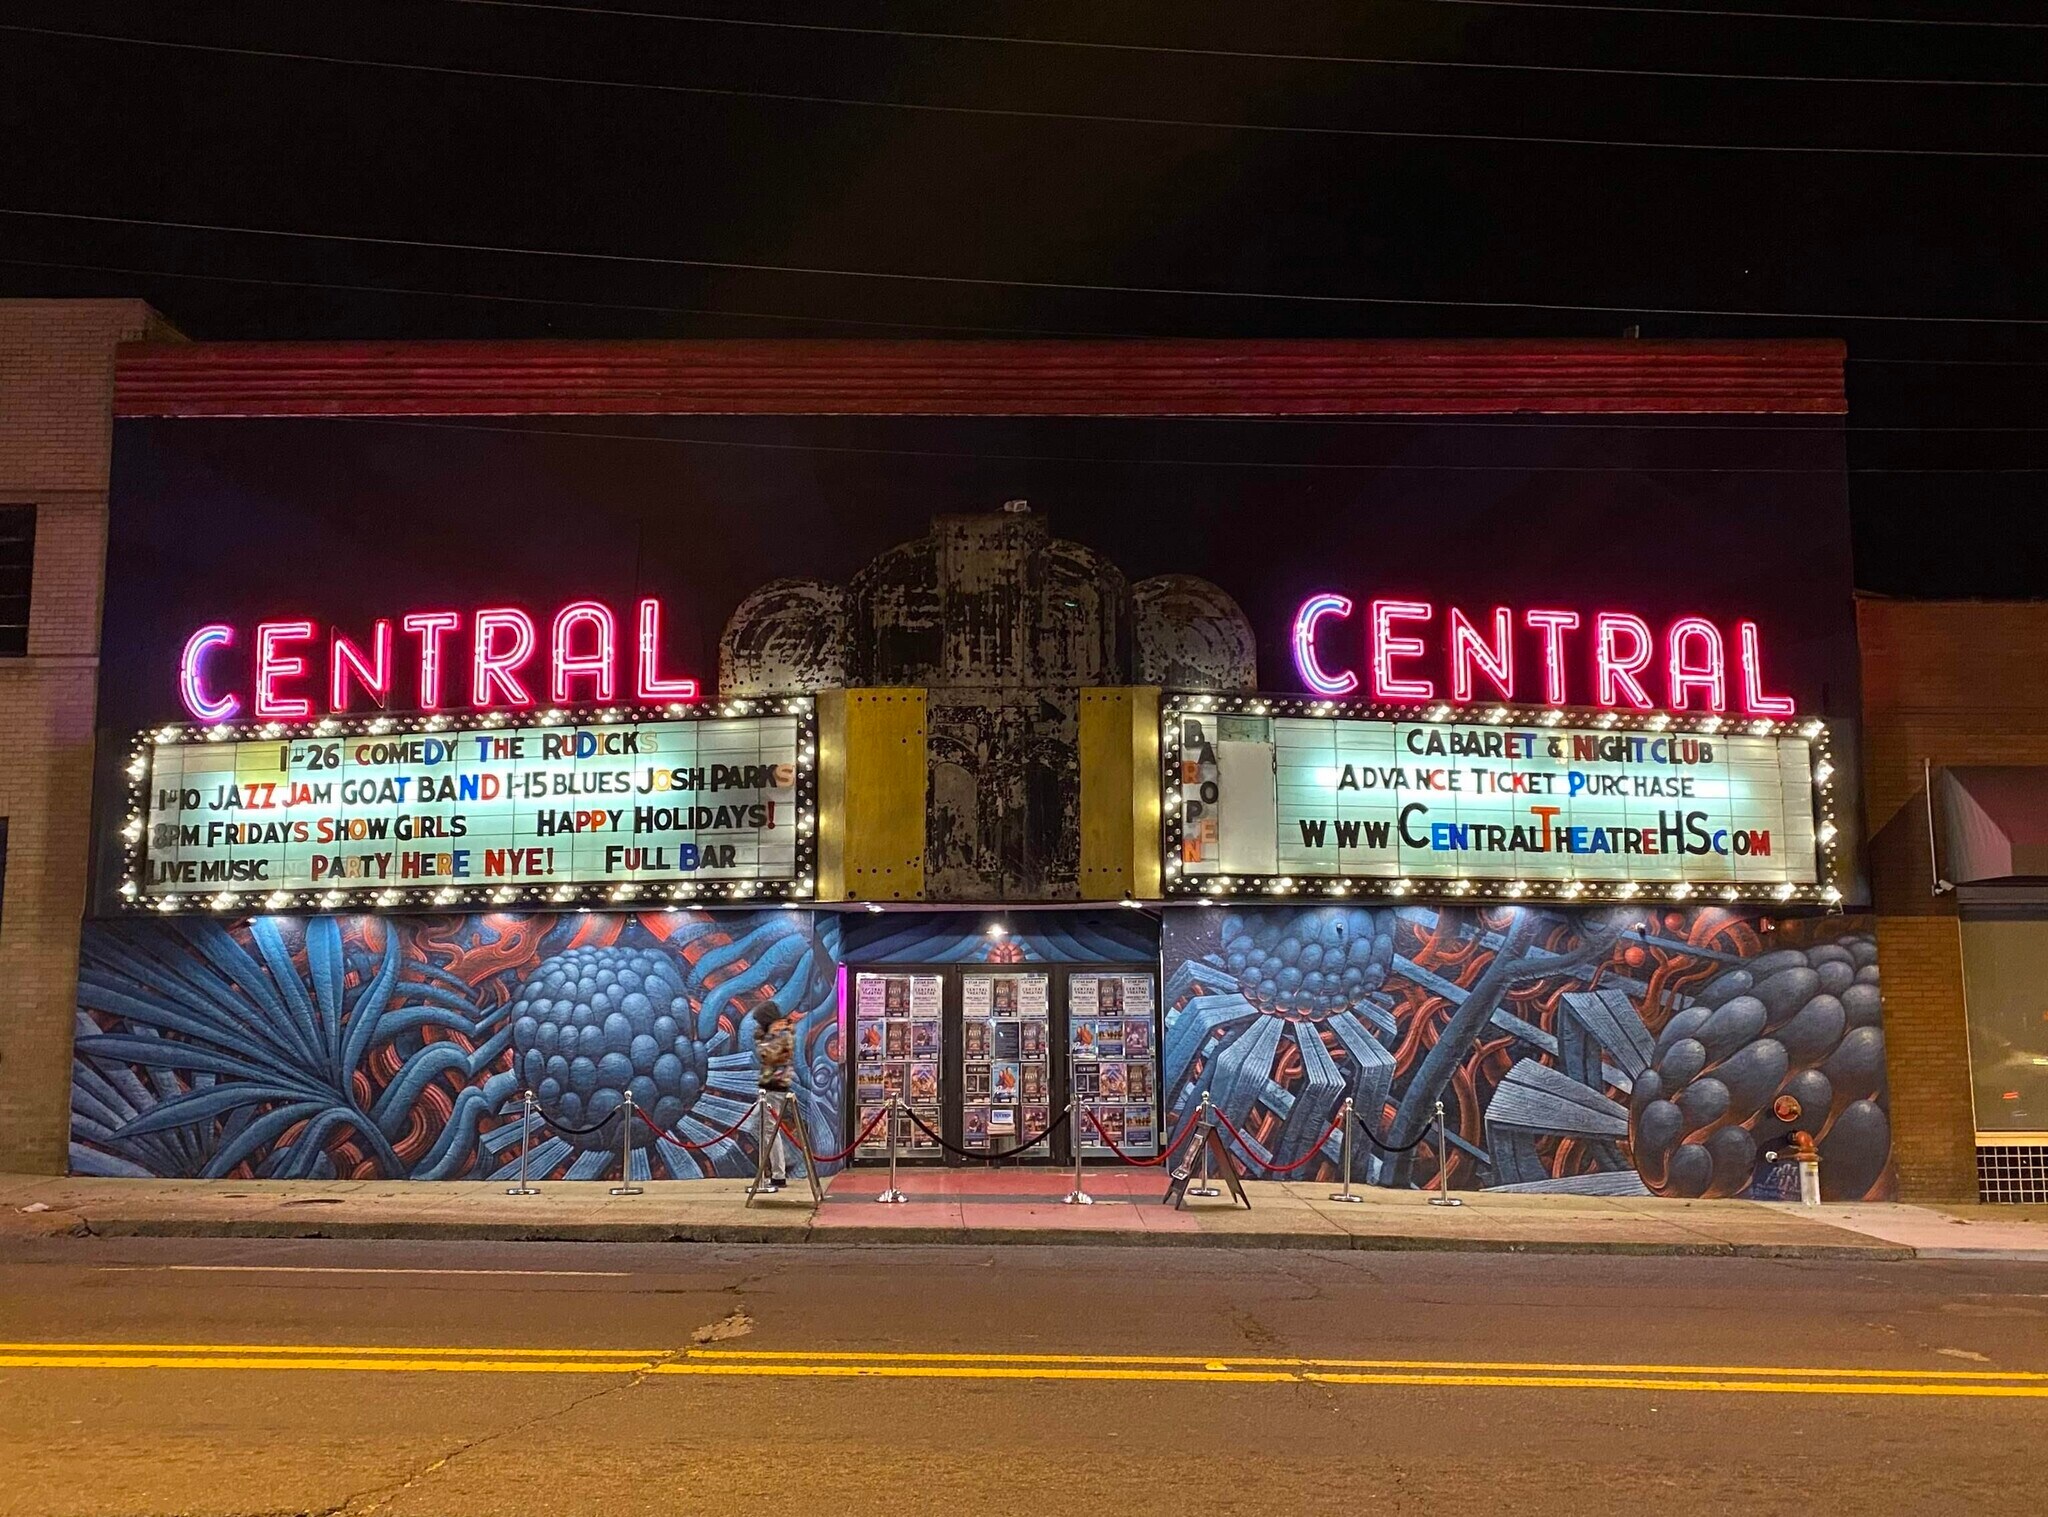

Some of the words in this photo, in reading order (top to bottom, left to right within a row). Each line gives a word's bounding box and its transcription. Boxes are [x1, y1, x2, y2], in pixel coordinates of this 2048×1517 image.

[180, 598, 698, 720] CENTRAL
[1292, 592, 1795, 716] CENTRAL
[355, 737, 457, 766] COMEDY
[475, 735, 525, 763] THE
[542, 730, 659, 761] RUDICKS
[1406, 728, 1538, 759] CABARET
[208, 782, 277, 811] JAZZ
[282, 781, 332, 808] JAM
[340, 777, 412, 804] GOAT
[417, 774, 500, 802] BAND
[552, 771, 631, 796] BLUES
[636, 766, 705, 794] JOSH
[710, 763, 795, 793] PARKS
[1338, 763, 1462, 792] ADVANCE
[1471, 768, 1557, 794] TICKET
[1568, 771, 1695, 798] PURCHASE
[153, 822, 200, 850] 8PM
[207, 820, 309, 848] FRIDAYS
[316, 816, 389, 843] SHOW
[393, 814, 467, 841] GIRLS
[537, 809, 624, 837] HAPPY
[633, 801, 776, 834] HOLIDAYS!
[147, 859, 197, 886] LIVE
[200, 859, 269, 882] MUSIC
[311, 852, 392, 882] PARTY
[401, 849, 471, 879] HERE
[484, 847, 555, 877] NYE!
[605, 845, 671, 874] FULL
[679, 842, 737, 872] BAR
